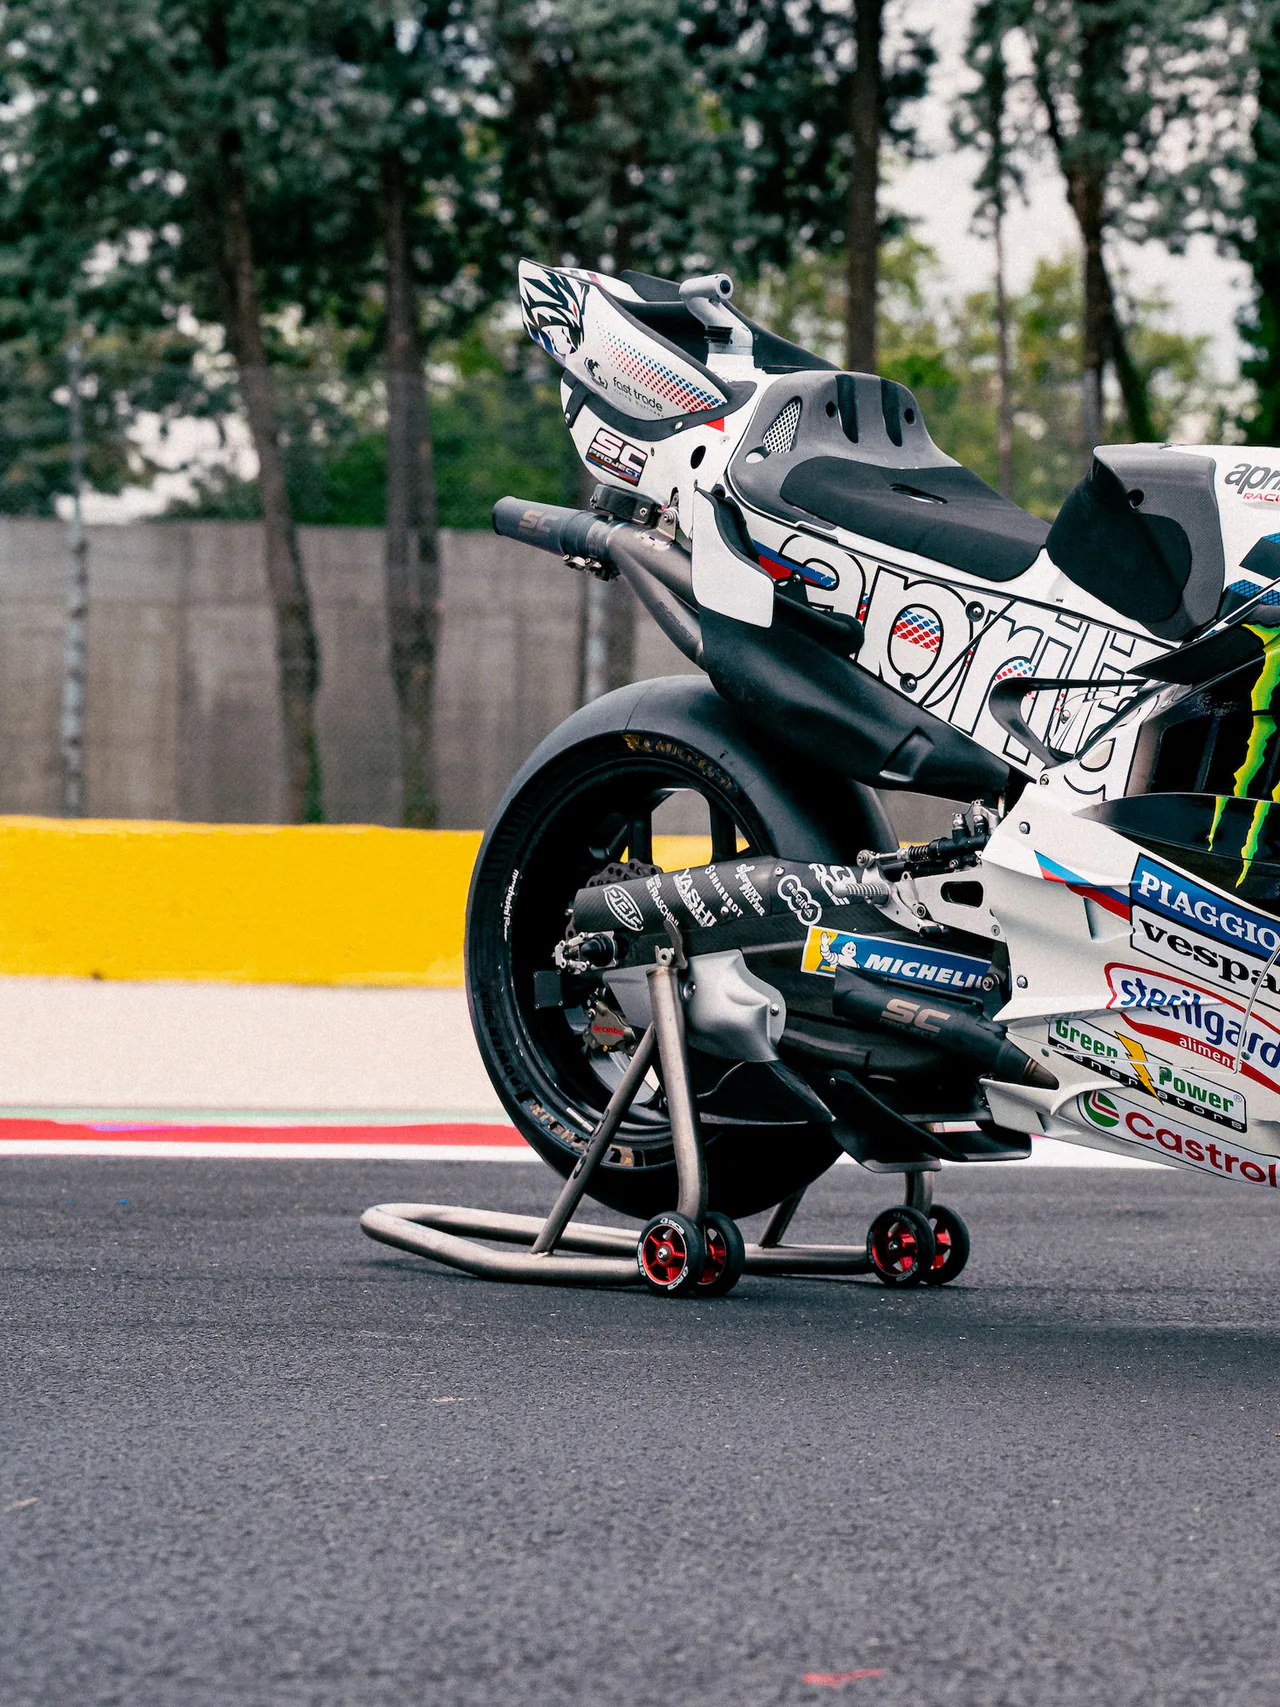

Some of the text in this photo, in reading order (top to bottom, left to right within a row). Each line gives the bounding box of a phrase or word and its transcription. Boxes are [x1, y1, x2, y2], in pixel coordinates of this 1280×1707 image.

[613, 376, 632, 397] fast
[633, 388, 663, 412] trade
[588, 449, 641, 478] PROJECT
[590, 429, 648, 473] SC
[881, 998, 951, 1034] SC
[1056, 1019, 1235, 1113] Green Power
[1178, 1036, 1243, 1074] alimenti
[1125, 1111, 1279, 1188] Castrol
